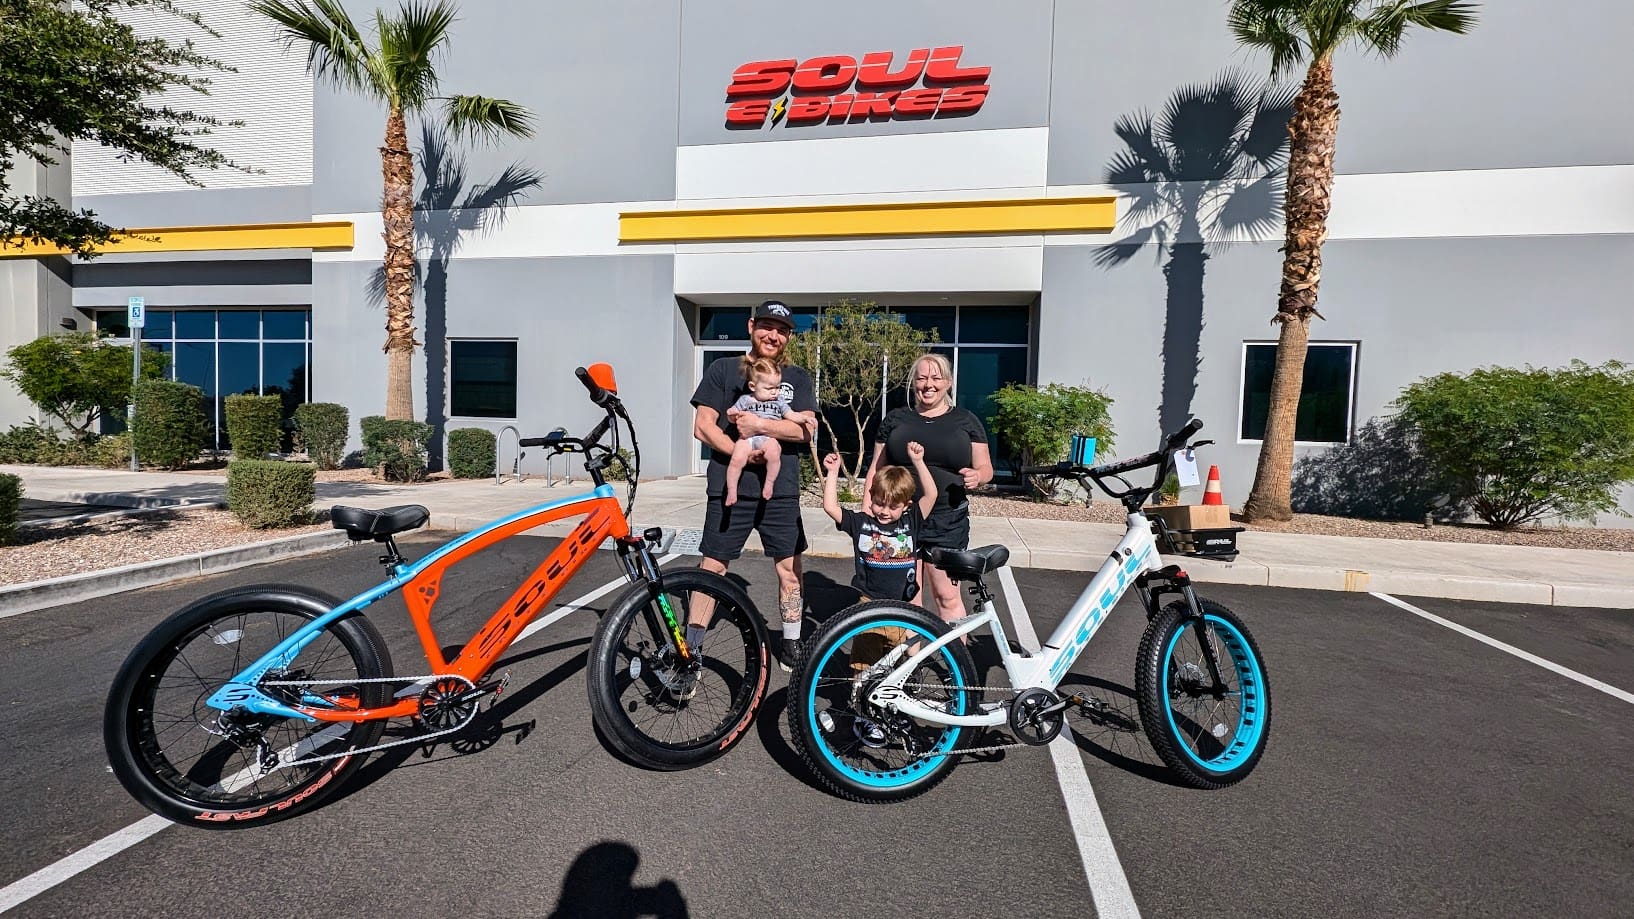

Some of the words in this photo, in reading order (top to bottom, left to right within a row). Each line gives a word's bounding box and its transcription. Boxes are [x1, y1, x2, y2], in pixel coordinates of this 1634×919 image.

[727, 46, 991, 98] SOUL
[786, 85, 990, 124] BIKES
[479, 507, 610, 659] SOUL
[1049, 544, 1151, 684] SOUL
[269, 771, 333, 811] SOUL
